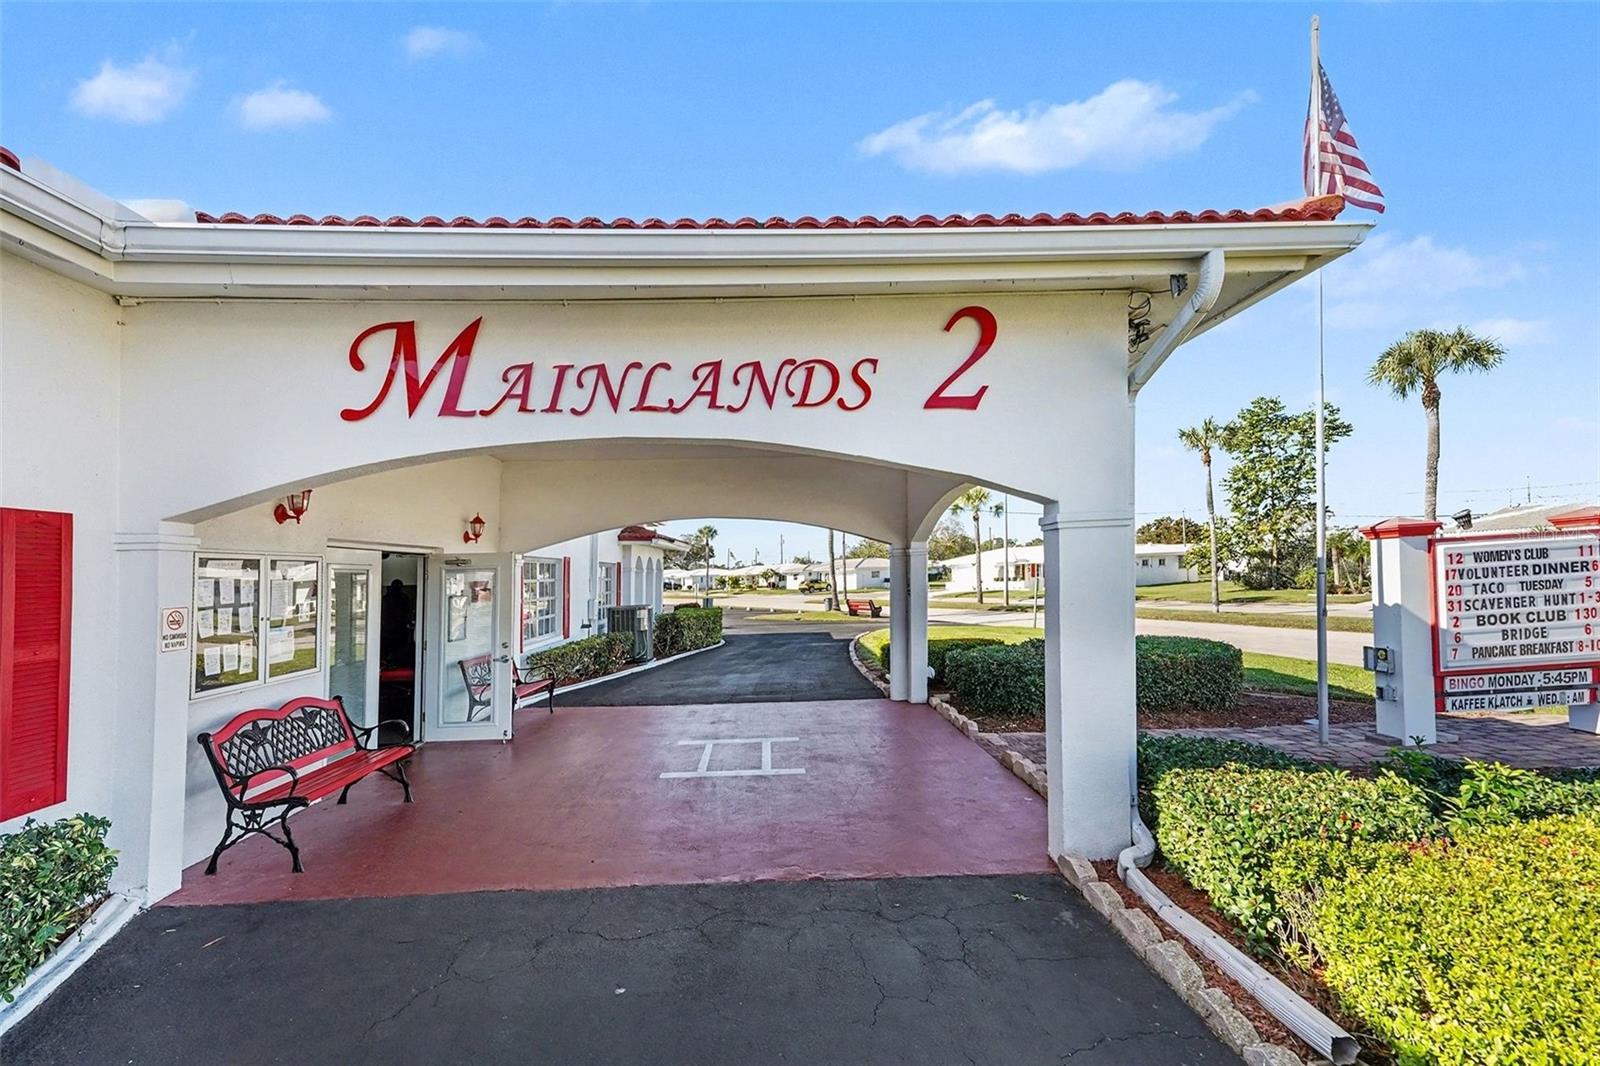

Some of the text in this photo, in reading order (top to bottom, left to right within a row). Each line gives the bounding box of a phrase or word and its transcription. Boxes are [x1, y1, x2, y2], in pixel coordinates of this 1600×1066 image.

[923, 305, 998, 411] 2
[1447, 553, 1464, 565] 12
[1473, 549, 1521, 563] WOMEN'S
[1524, 547, 1549, 560] CLUB
[1458, 565, 1529, 580] VOLUNTEER
[1532, 561, 1590, 575] DINNER
[1592, 560, 1599, 571] 6
[1447, 576, 1592, 597] 20 TACO TUESDAY 5
[1447, 601, 1463, 612] 31
[1464, 596, 1536, 612] SCAVENGER
[1544, 593, 1577, 607] HUNT
[1453, 616, 1460, 628] 2
[1476, 612, 1521, 627] BOOK
[1526, 610, 1567, 623] CLUB
[1454, 624, 1592, 643] 6 BRIDGE 6
[1452, 648, 1458, 659] 7
[1472, 645, 1517, 659] PANCAKE
[1520, 641, 1575, 656] BREAKFAST
[1449, 677, 1485, 690] BINGO
[1488, 674, 1535, 688] MONDAY
[1543, 671, 1588, 685] 5:45PM
[1451, 697, 1486, 711] KAFFEE
[1488, 695, 1523, 709] KLATCH
[1537, 693, 1560, 706] WED.
